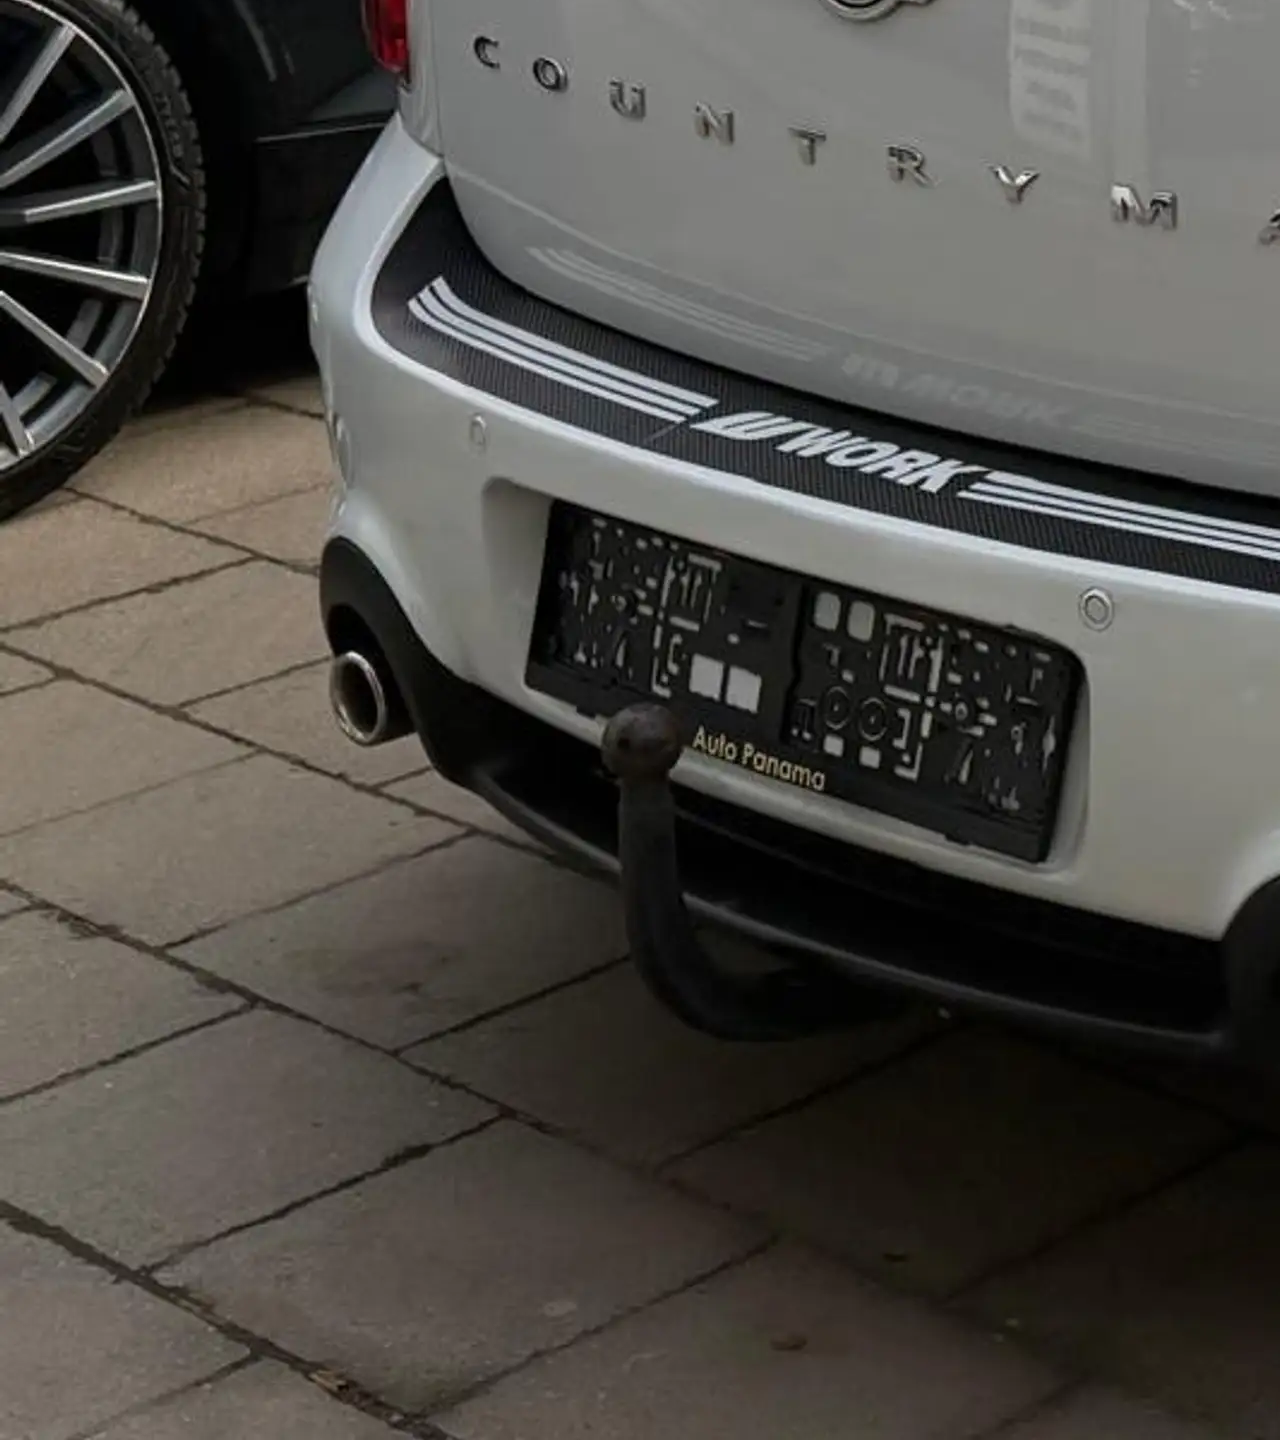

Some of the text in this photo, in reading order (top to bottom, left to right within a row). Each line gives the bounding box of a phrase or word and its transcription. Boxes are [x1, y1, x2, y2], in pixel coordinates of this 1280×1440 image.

[772, 422, 992, 494] WORK
[692, 724, 828, 793] Auto Panama
